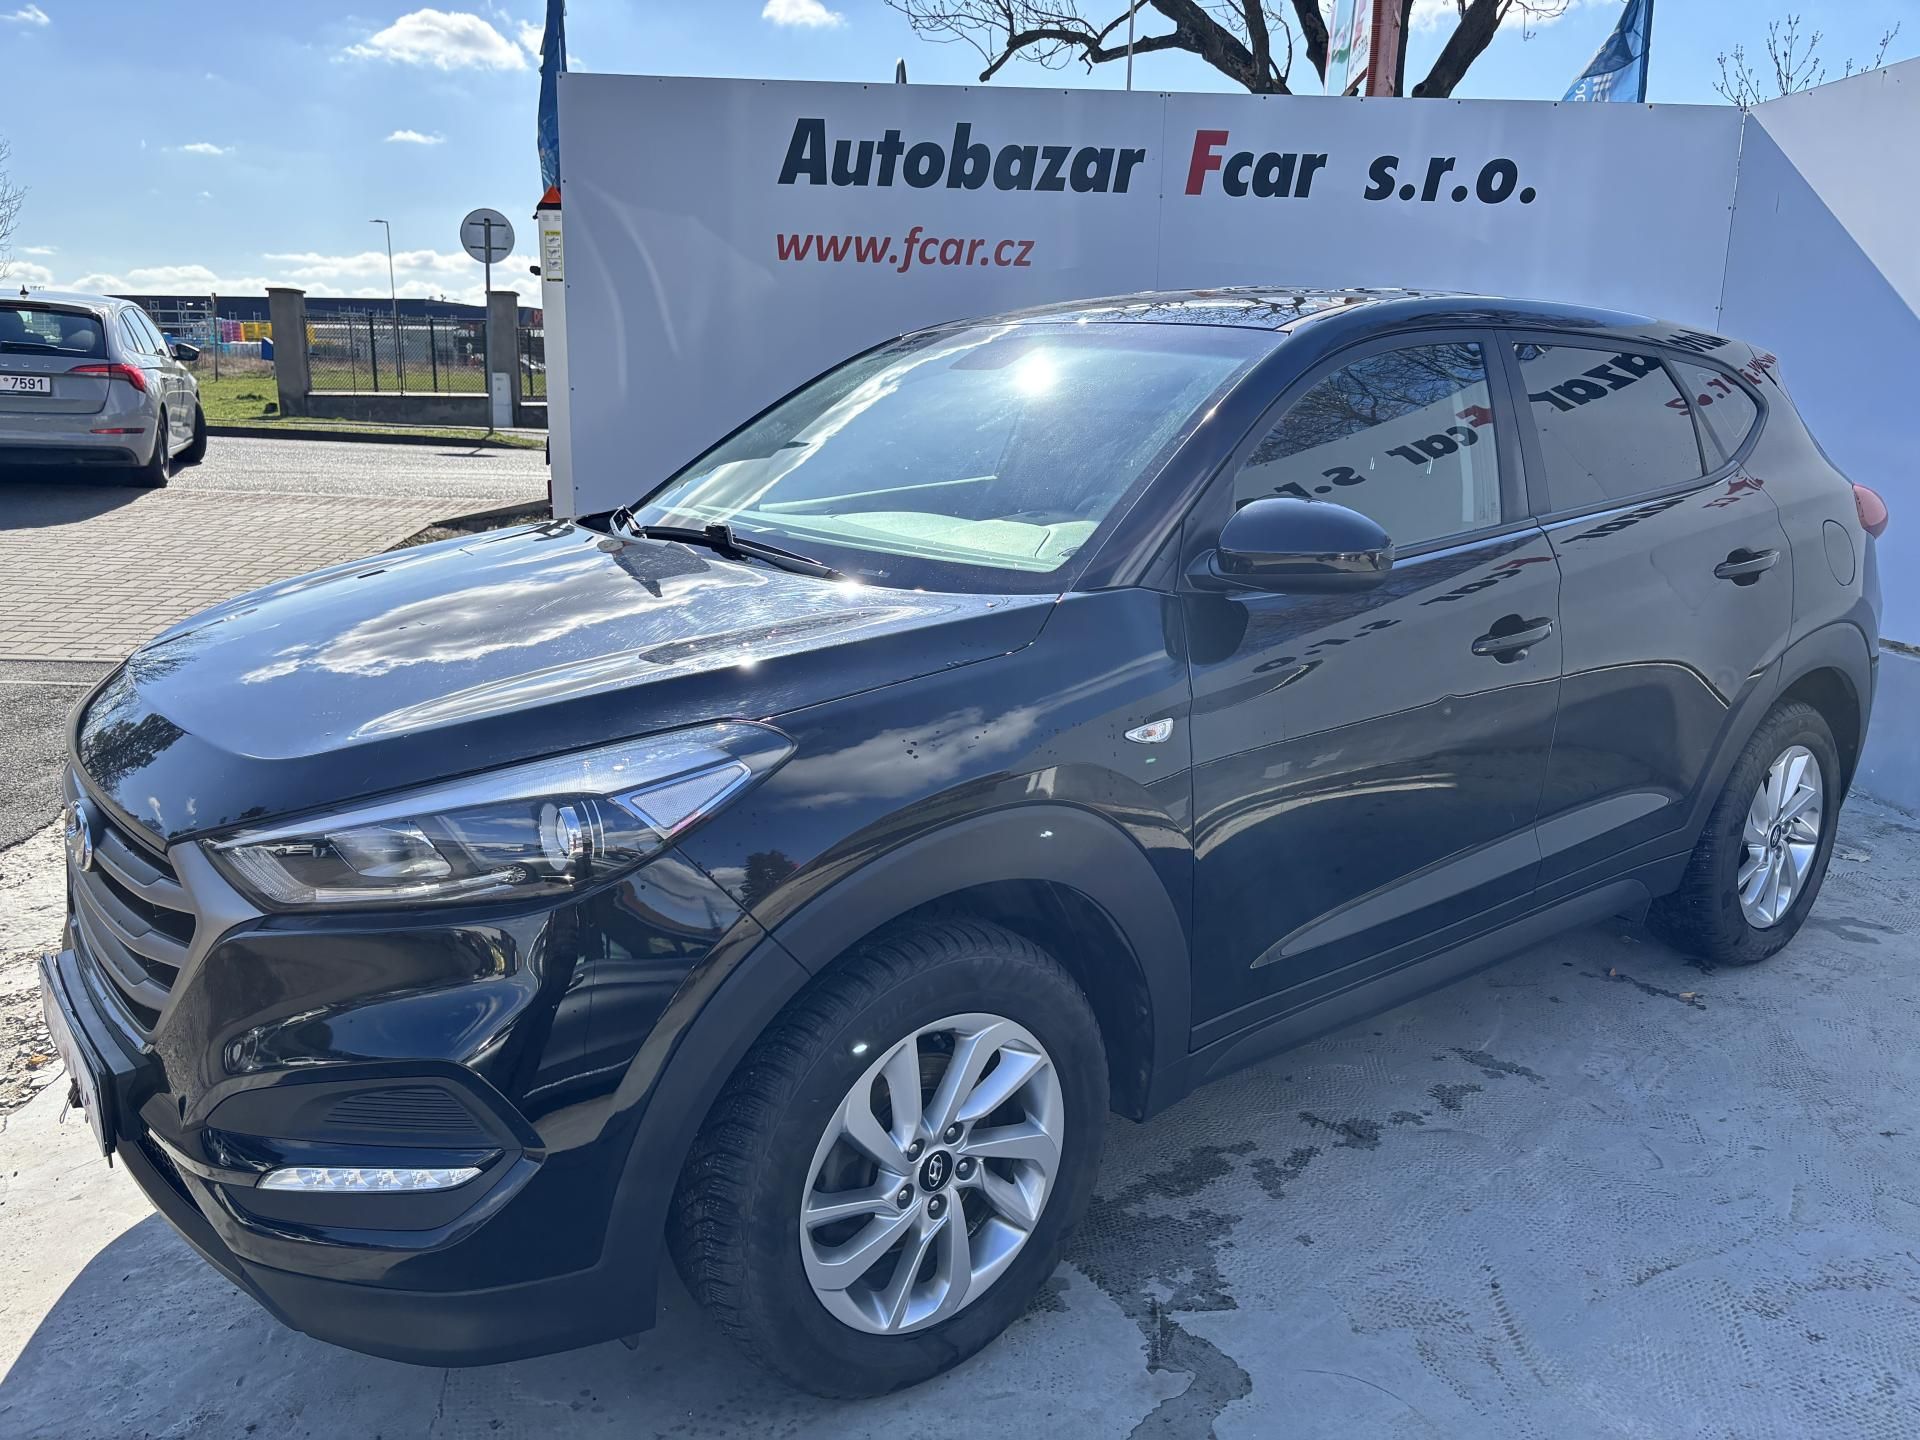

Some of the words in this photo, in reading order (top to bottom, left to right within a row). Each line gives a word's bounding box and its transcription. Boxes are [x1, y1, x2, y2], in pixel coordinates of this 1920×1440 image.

[777, 117, 1147, 194] Autobazar
[1184, 129, 1329, 198] Fcar
[1363, 154, 1537, 204] s.r.o.
[776, 226, 1036, 274] www.fcar.cz
[10, 377, 44, 391] 7591
